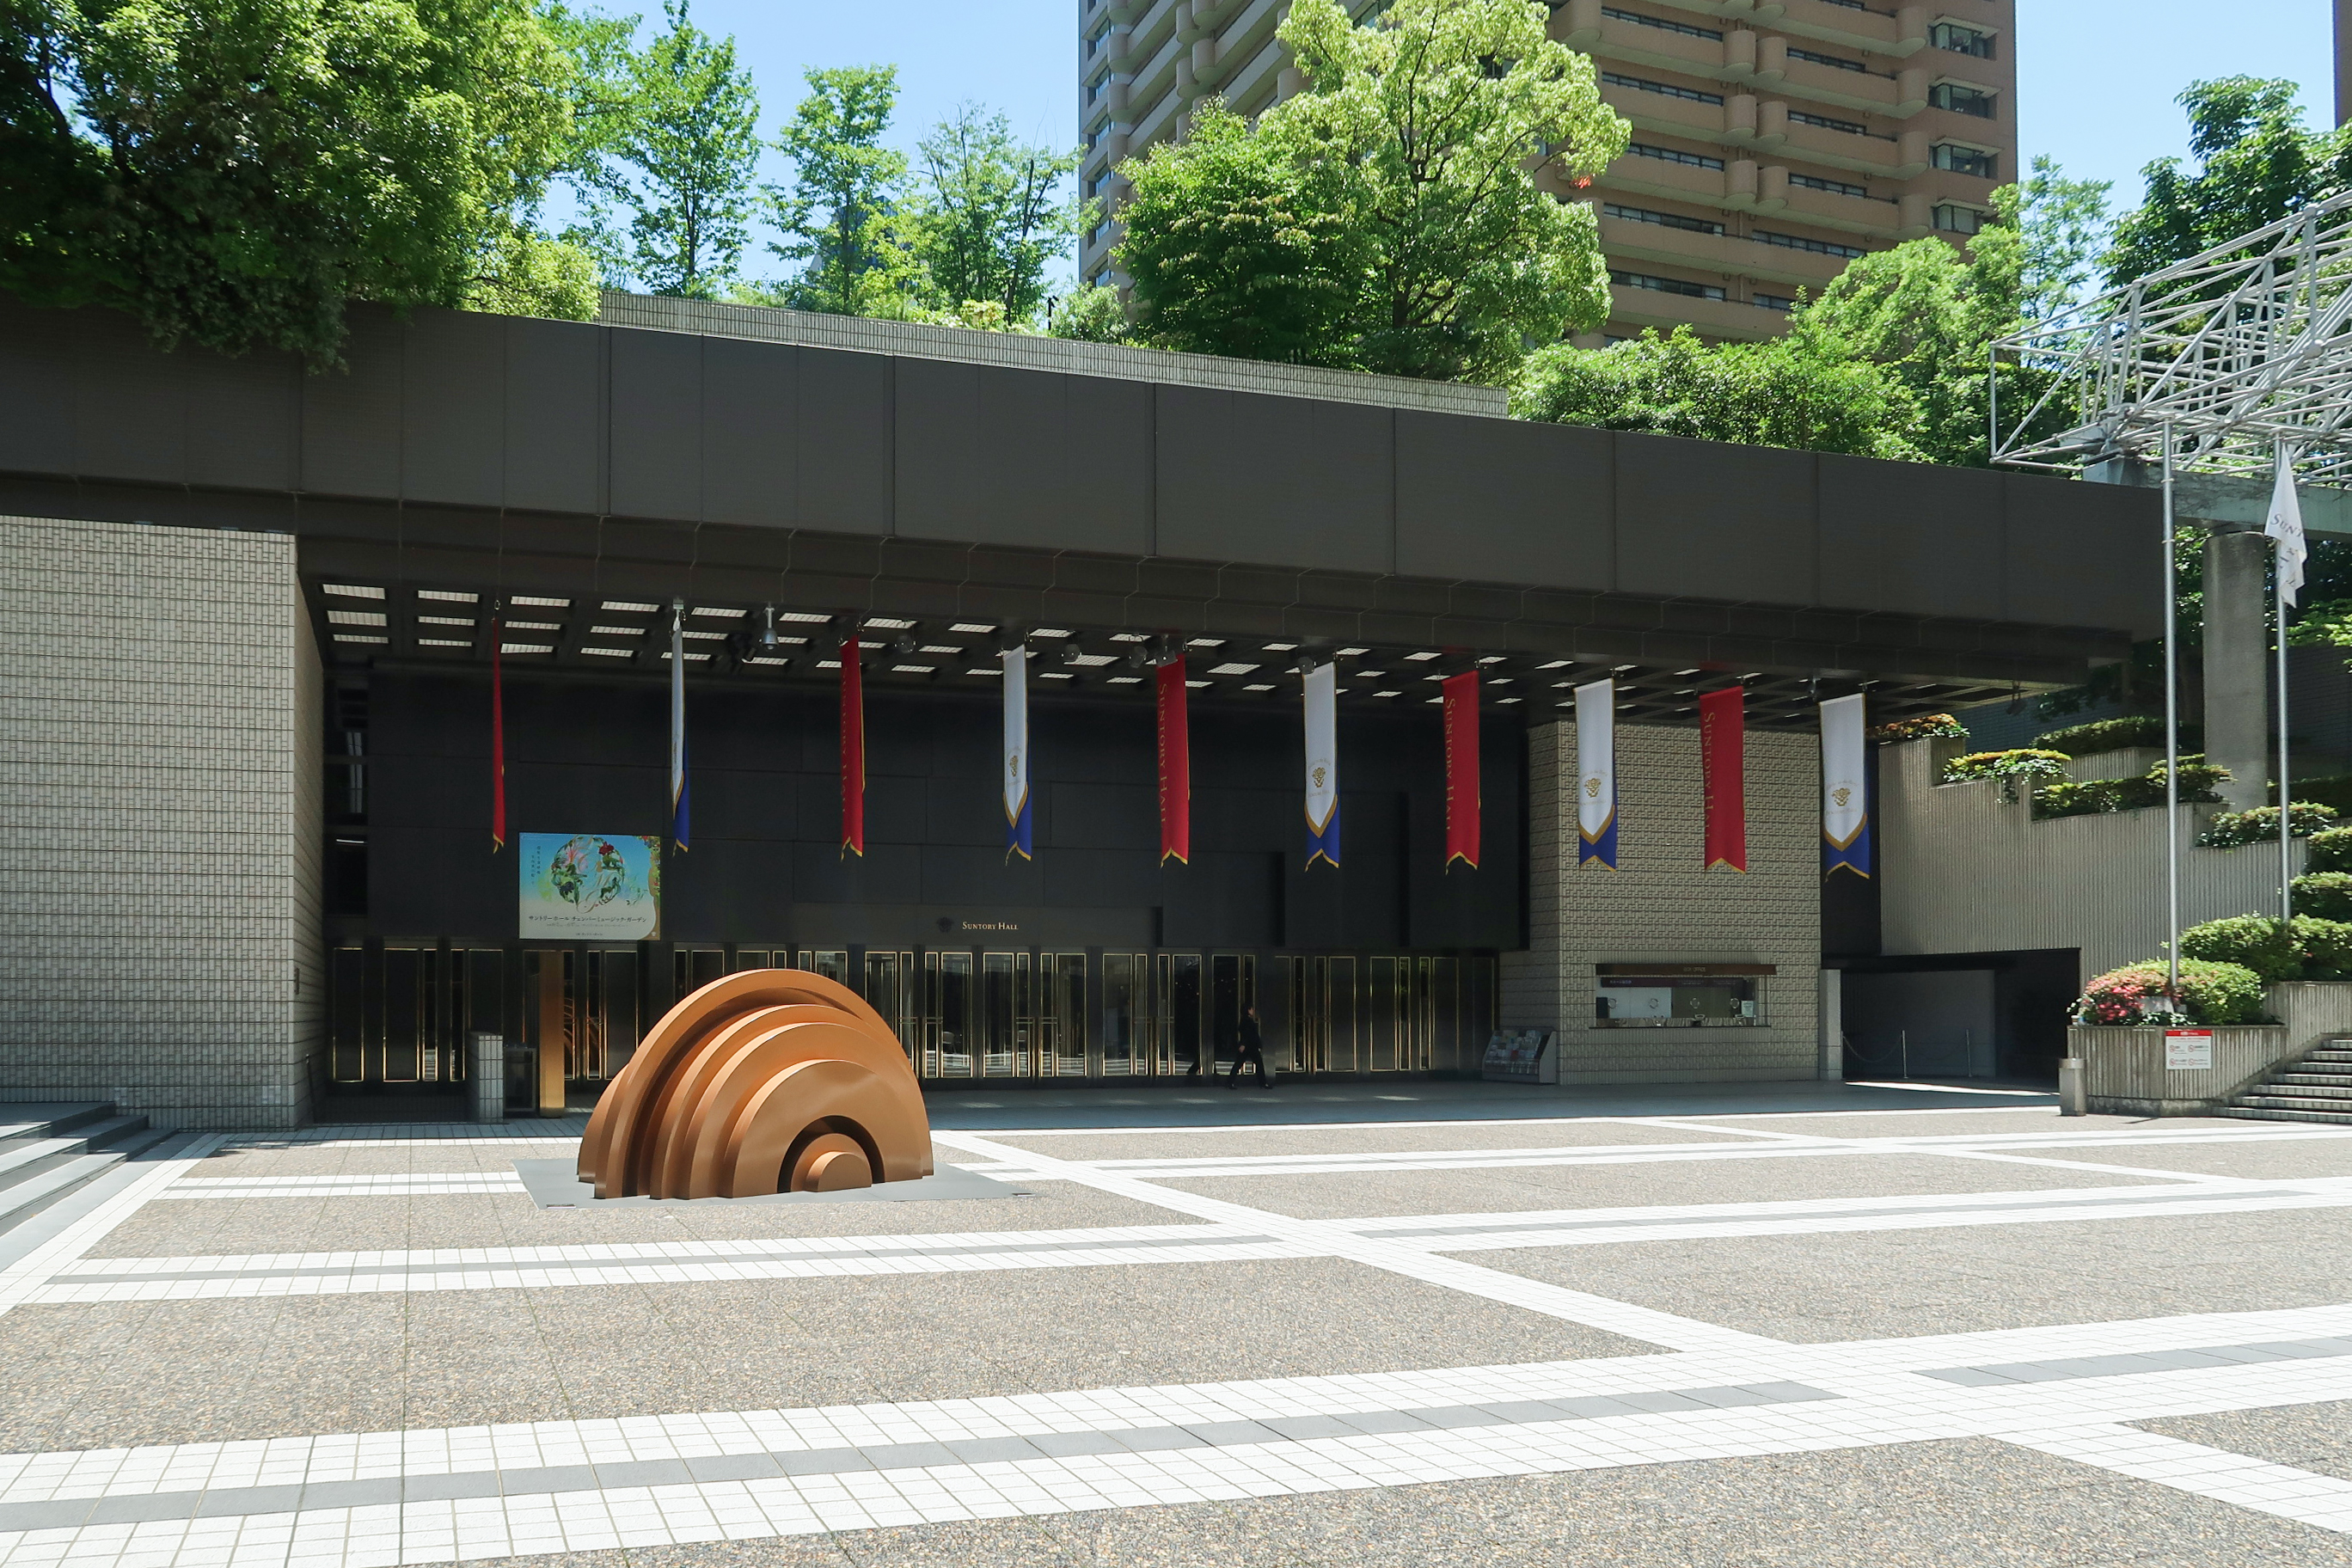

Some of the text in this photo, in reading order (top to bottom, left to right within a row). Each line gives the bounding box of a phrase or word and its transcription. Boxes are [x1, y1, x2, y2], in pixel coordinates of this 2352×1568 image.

[1159, 683, 1167, 769] SUNTORY
[1445, 698, 1456, 780] SUNTORY
[1704, 712, 1716, 789] SUNTORY
[962, 921, 1019, 930] SUNTORY HALL
